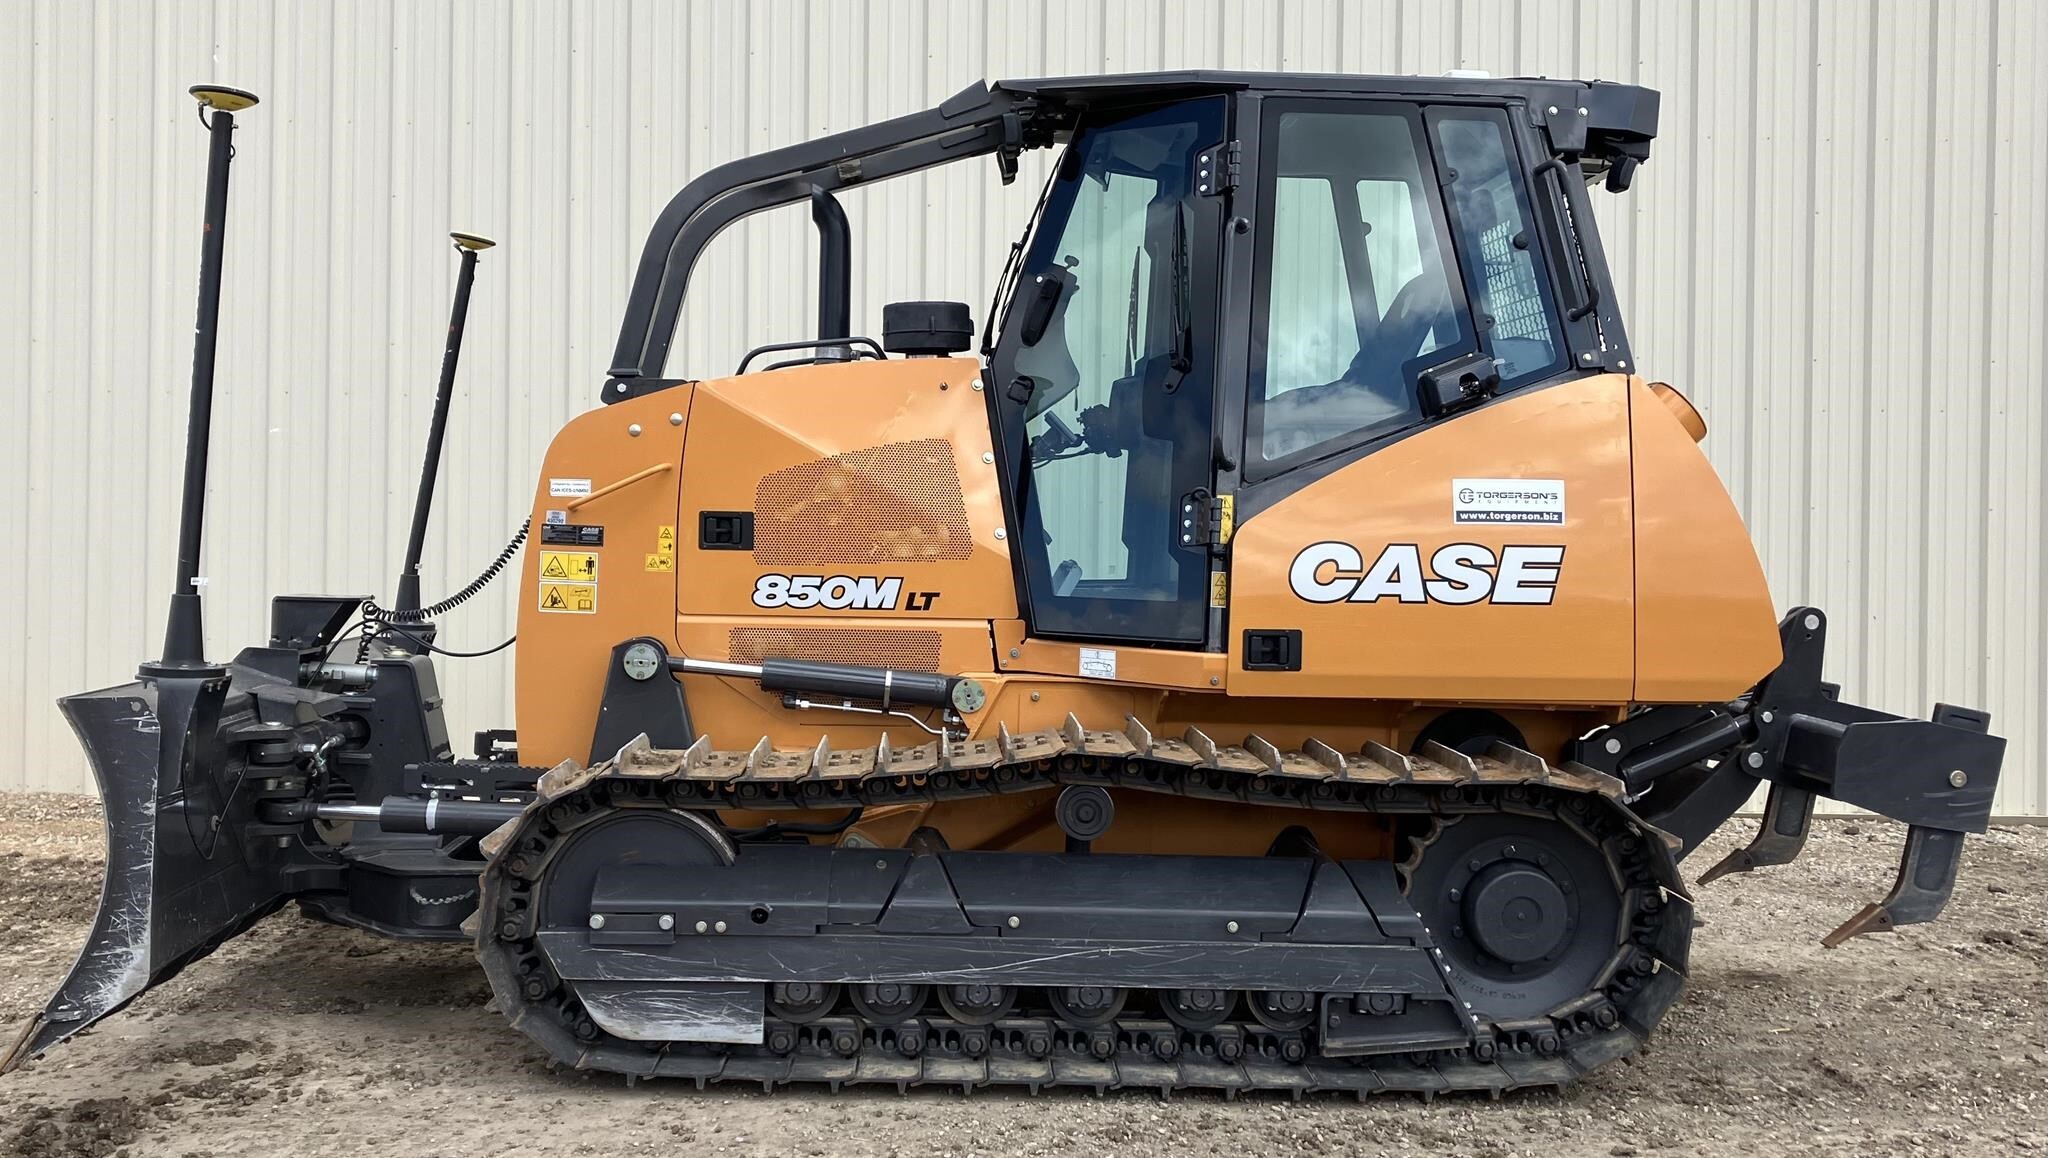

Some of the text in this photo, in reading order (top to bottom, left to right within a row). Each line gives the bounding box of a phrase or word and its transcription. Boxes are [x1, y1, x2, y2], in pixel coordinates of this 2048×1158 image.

[1476, 491, 1558, 500] TORGERSON'S
[1460, 511, 1559, 521] www.torgerson.biz
[1288, 540, 1566, 605] CASE
[752, 573, 941, 611] 850M LT
